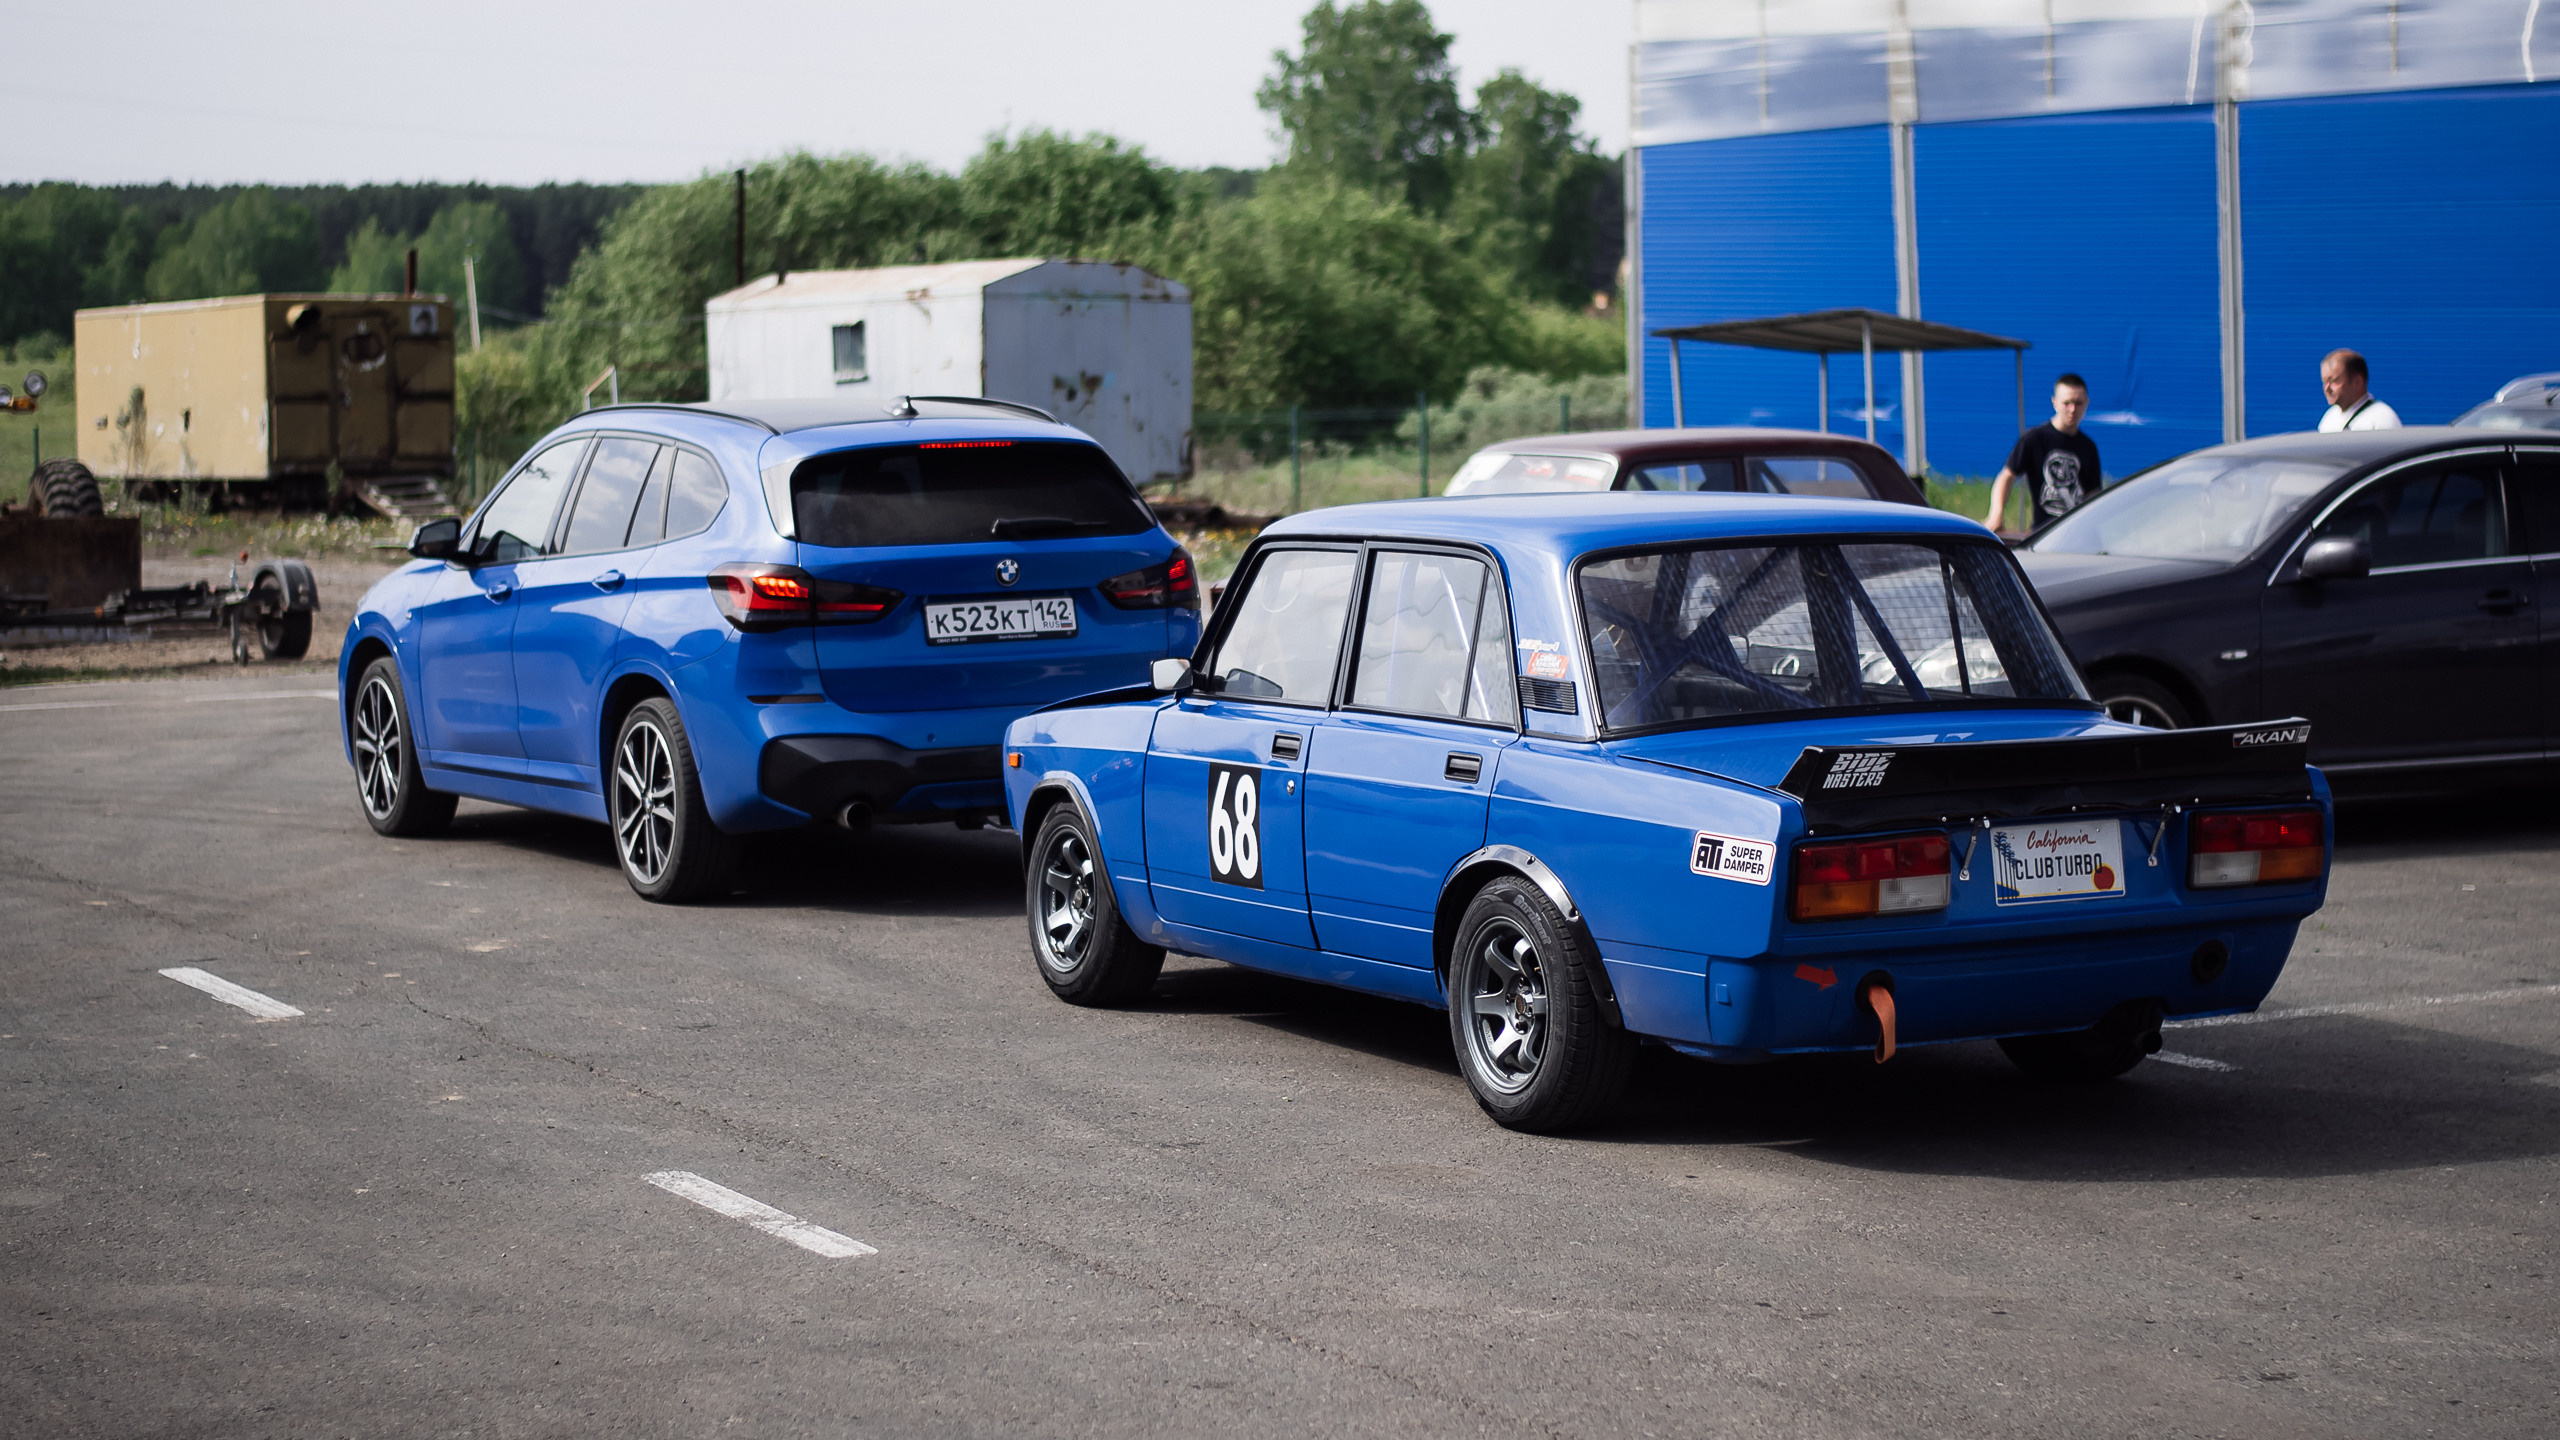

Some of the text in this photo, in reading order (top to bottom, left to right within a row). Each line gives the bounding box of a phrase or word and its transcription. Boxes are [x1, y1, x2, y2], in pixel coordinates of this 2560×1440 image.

[1035, 601, 1069, 621] 142
[1043, 620, 1061, 629] RUS
[2240, 729, 2296, 745] AKAN
[1830, 752, 1896, 773] SIDE
[1822, 771, 1886, 789] MASTERS
[1210, 771, 1259, 880] 68
[2026, 829, 2097, 853] California
[1695, 837, 1725, 871] ATI
[1730, 846, 1763, 861] SUPER
[1723, 858, 1765, 875] DAMPER
[2015, 853, 2103, 880] CLUBTURBO
